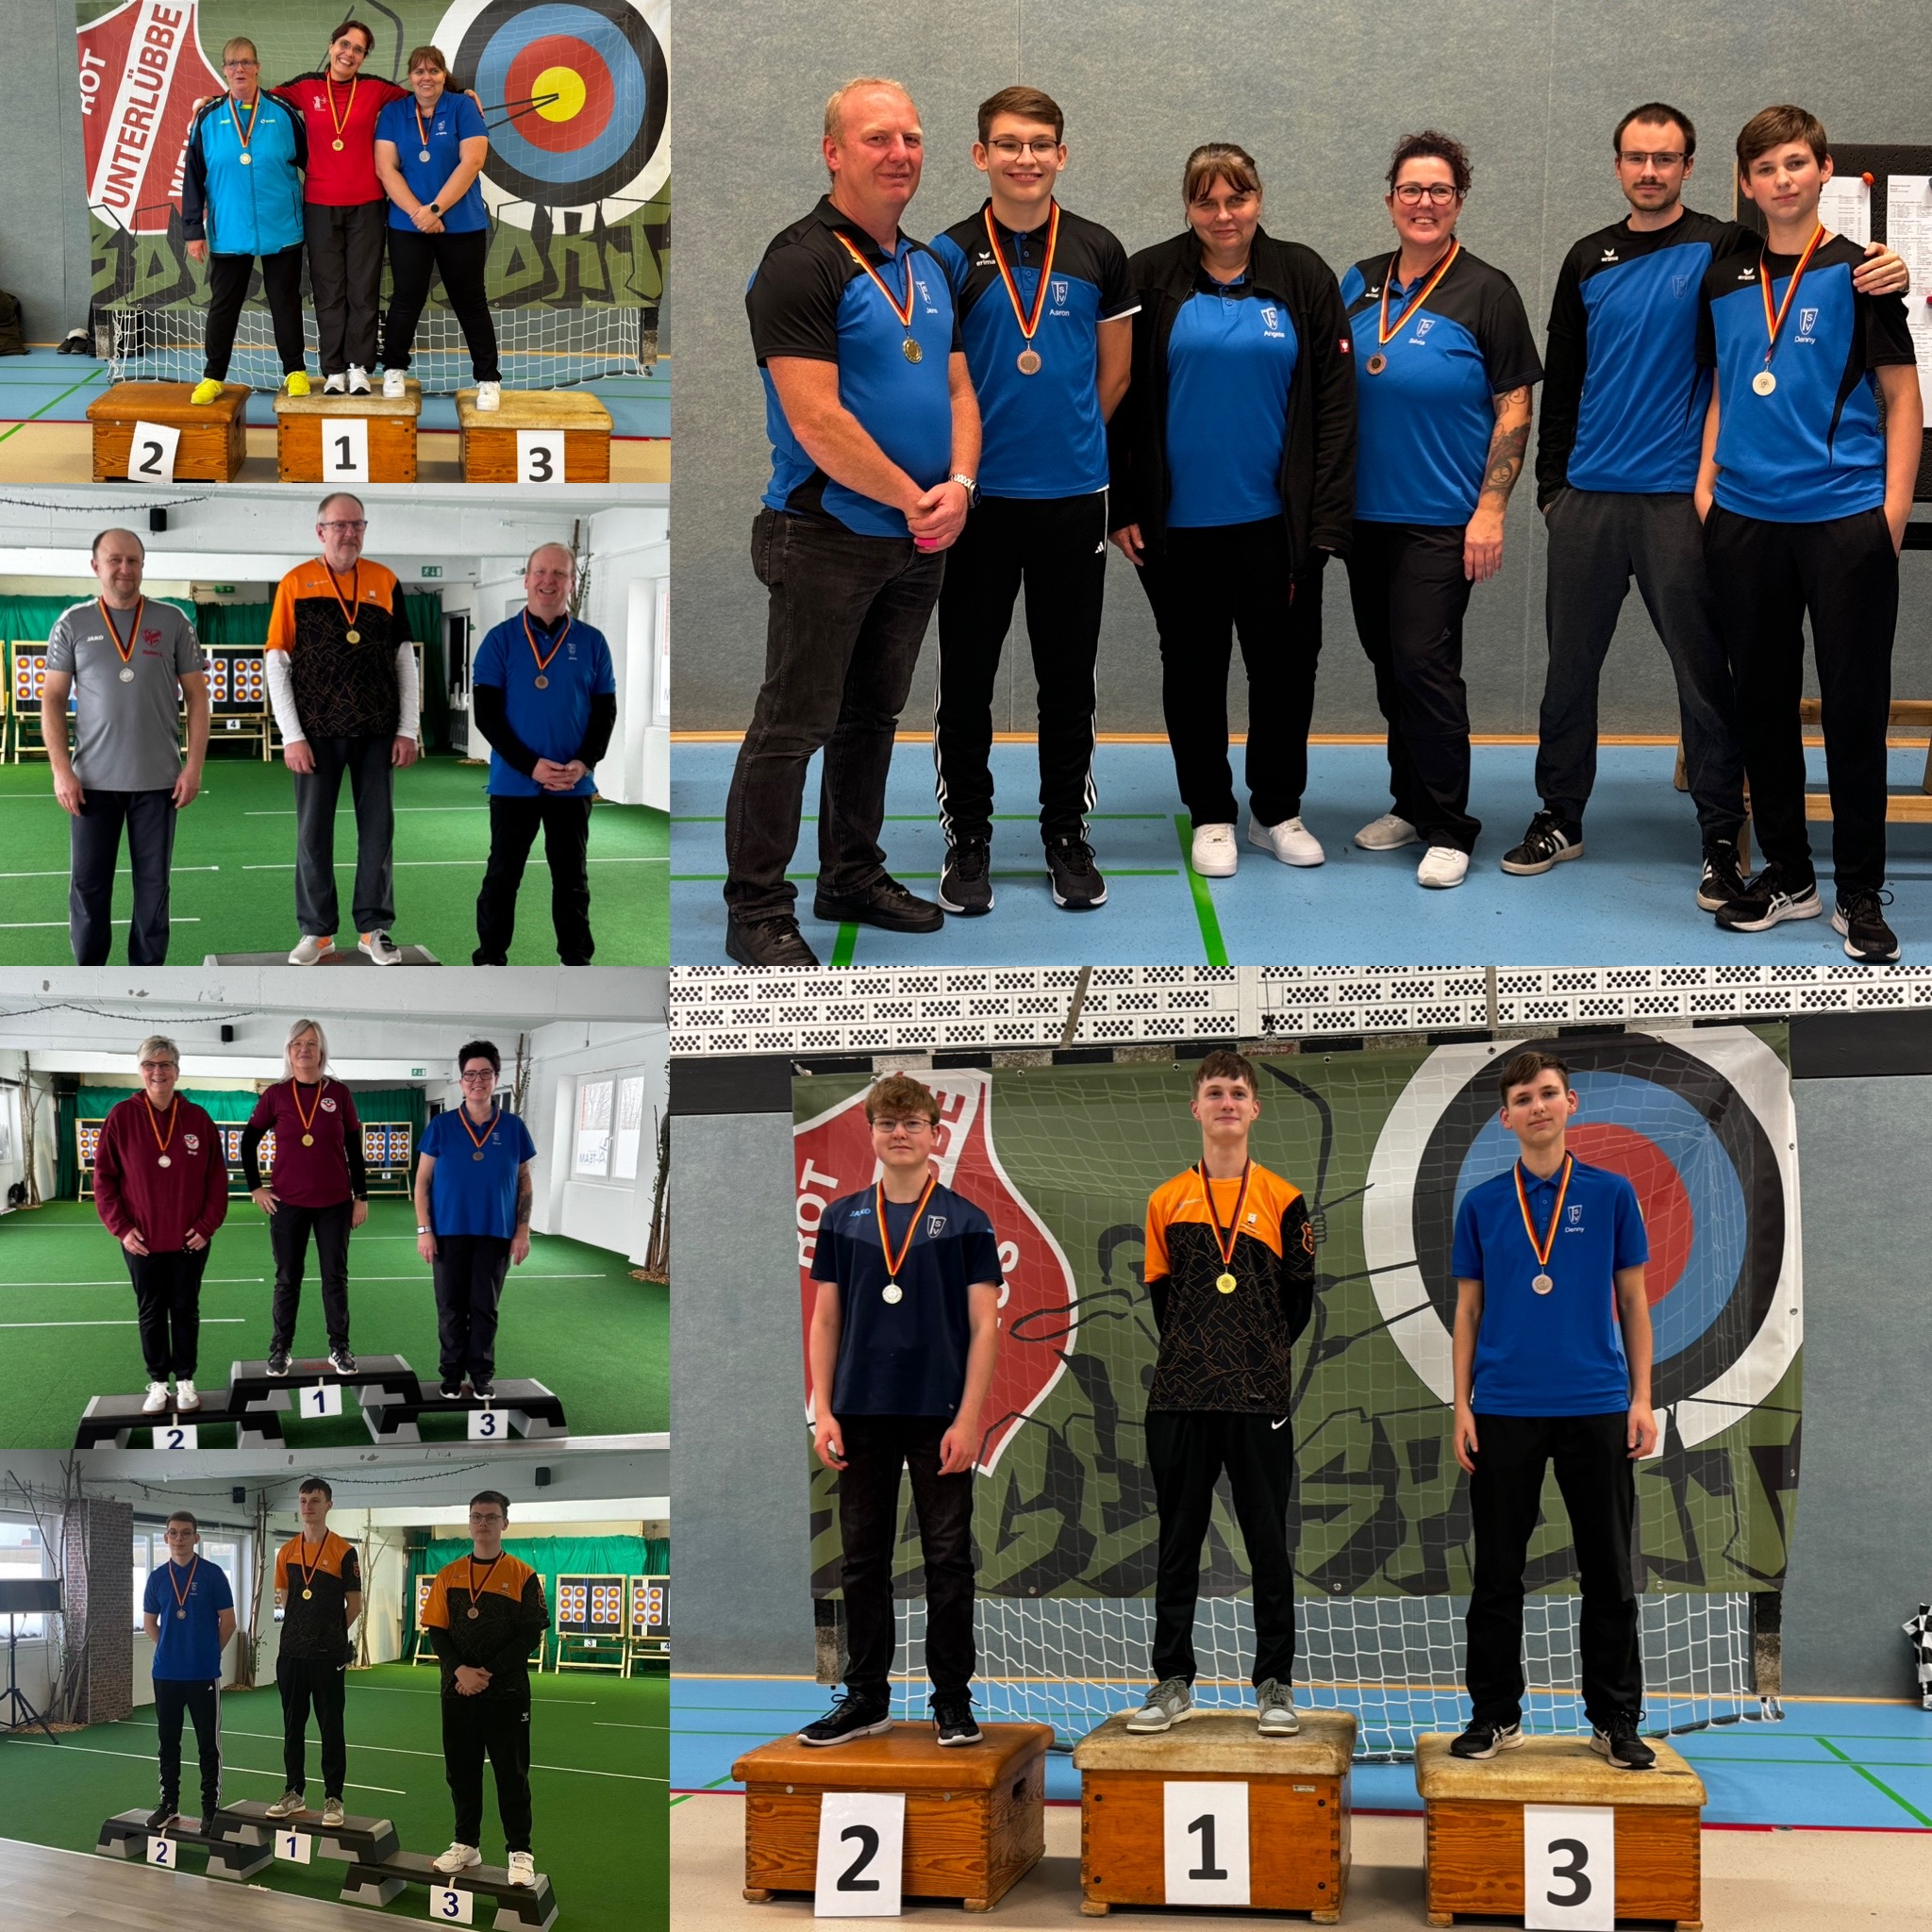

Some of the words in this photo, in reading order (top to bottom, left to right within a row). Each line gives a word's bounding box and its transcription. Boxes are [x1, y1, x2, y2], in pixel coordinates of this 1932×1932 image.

[101, 4, 183, 208] UNTERLÜBBE
[1052, 281, 1068, 304] TSV
[1800, 308, 1818, 333] TSV
[1794, 335, 1815, 344] Denny
[140, 441, 164, 475] 2
[335, 436, 358, 470] 1
[528, 446, 554, 482] 3
[849, 1208, 872, 1217] JAKO
[927, 1215, 946, 1238] TSV
[312, 1390, 325, 1414] 1
[479, 1412, 496, 1437] 3
[166, 1428, 186, 1450] 2
[587, 1639, 593, 1647] 3
[156, 1840, 168, 1864] 2
[286, 1836, 296, 1858] 1
[837, 1824, 880, 1892] 2
[1188, 1814, 1228, 1880] 1
[1546, 1838, 1592, 1907] 3
[442, 1891, 459, 1918] 3
